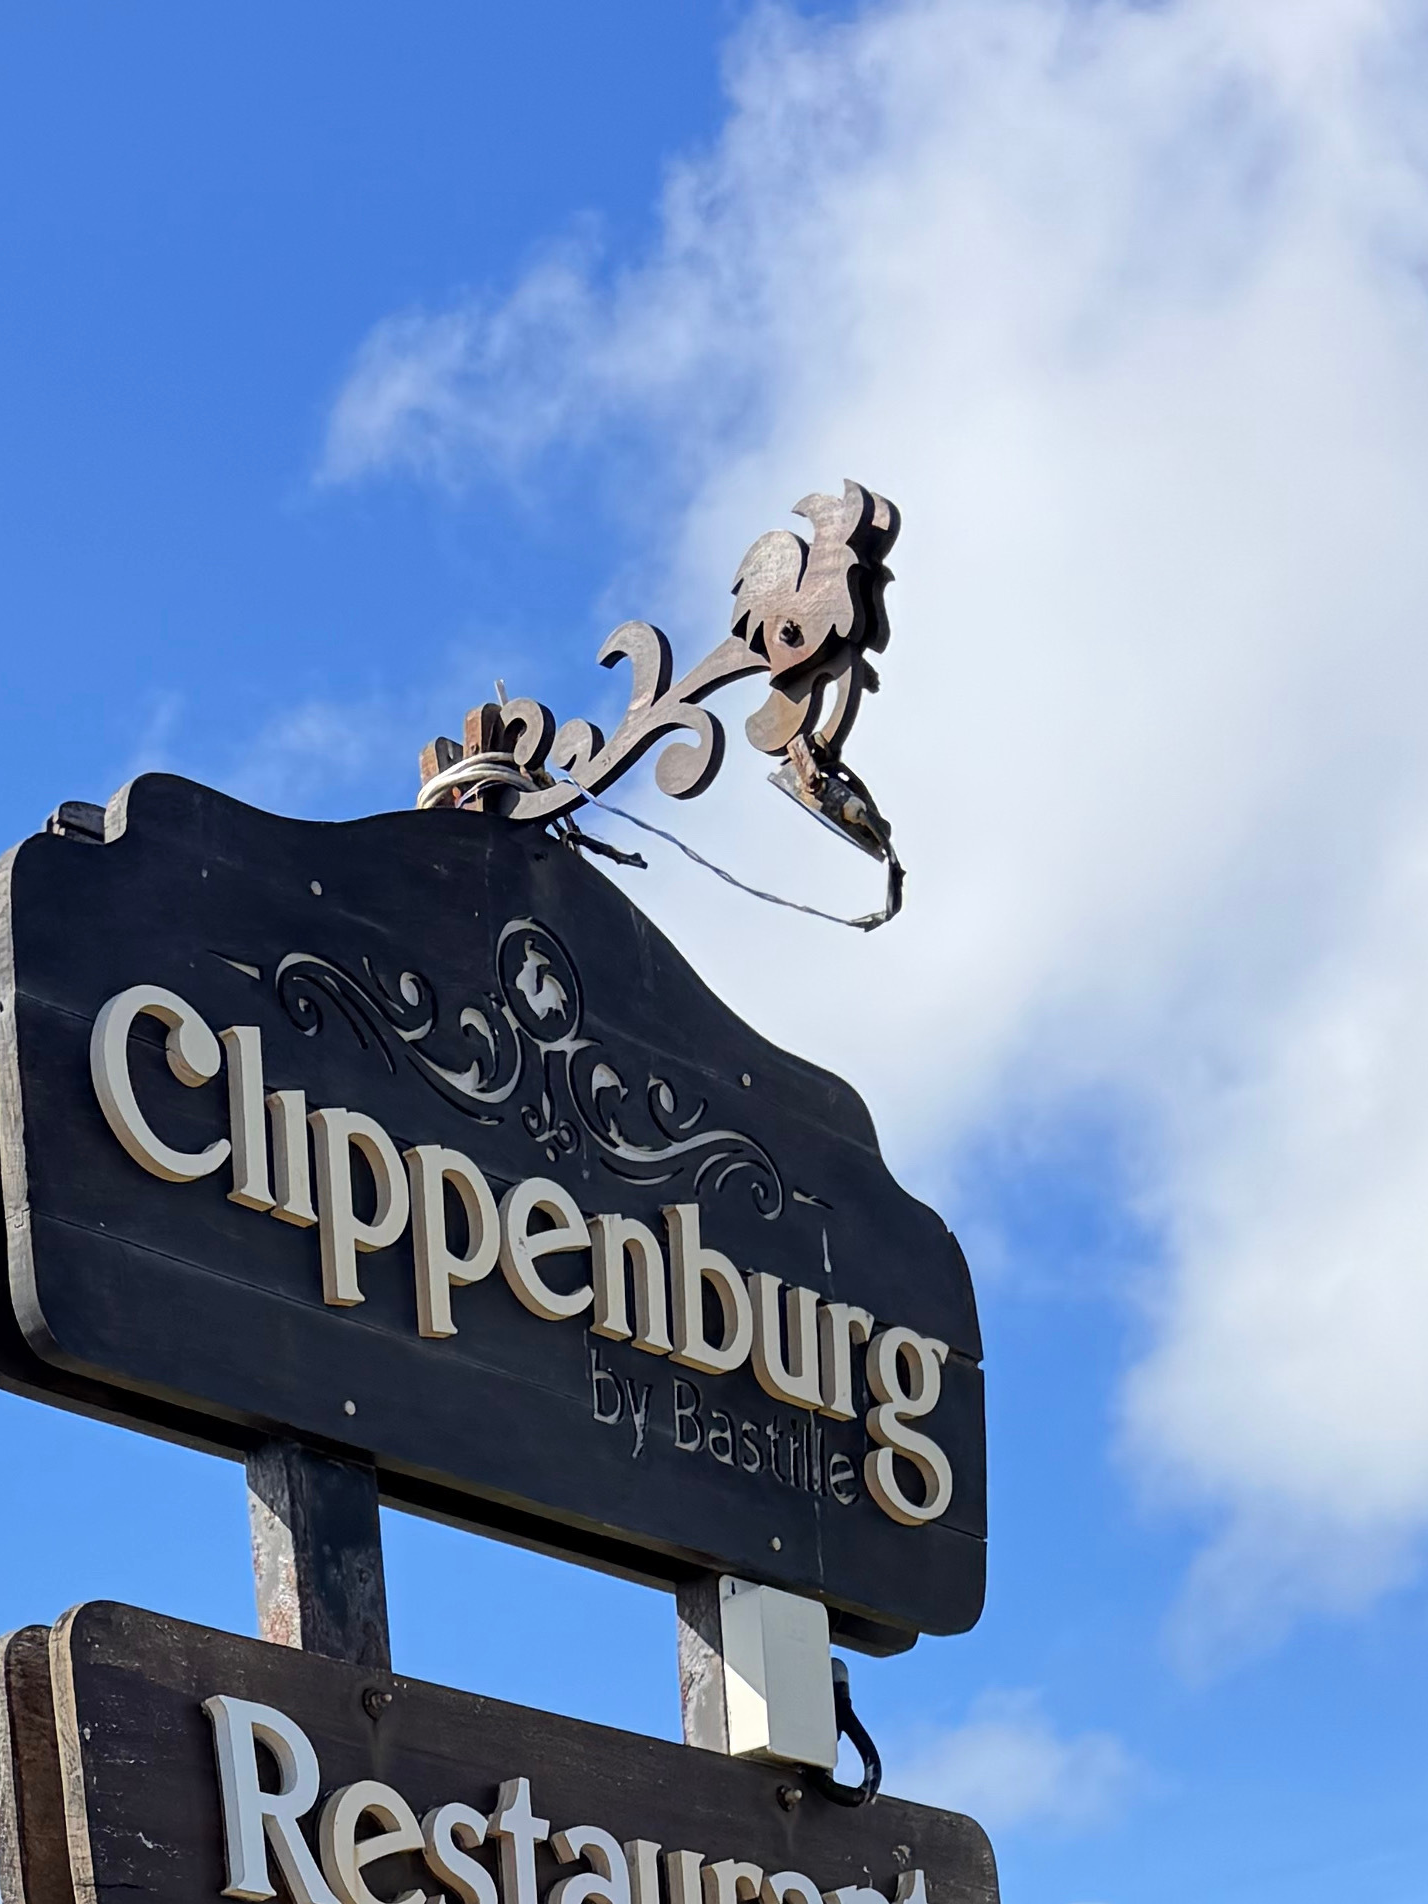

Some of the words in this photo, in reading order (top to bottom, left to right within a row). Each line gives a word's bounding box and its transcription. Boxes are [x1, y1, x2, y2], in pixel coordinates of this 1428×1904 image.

[89, 983, 953, 1526] Clippenburg
[590, 1347, 653, 1460] by
[673, 1377, 860, 1506] Bastille
